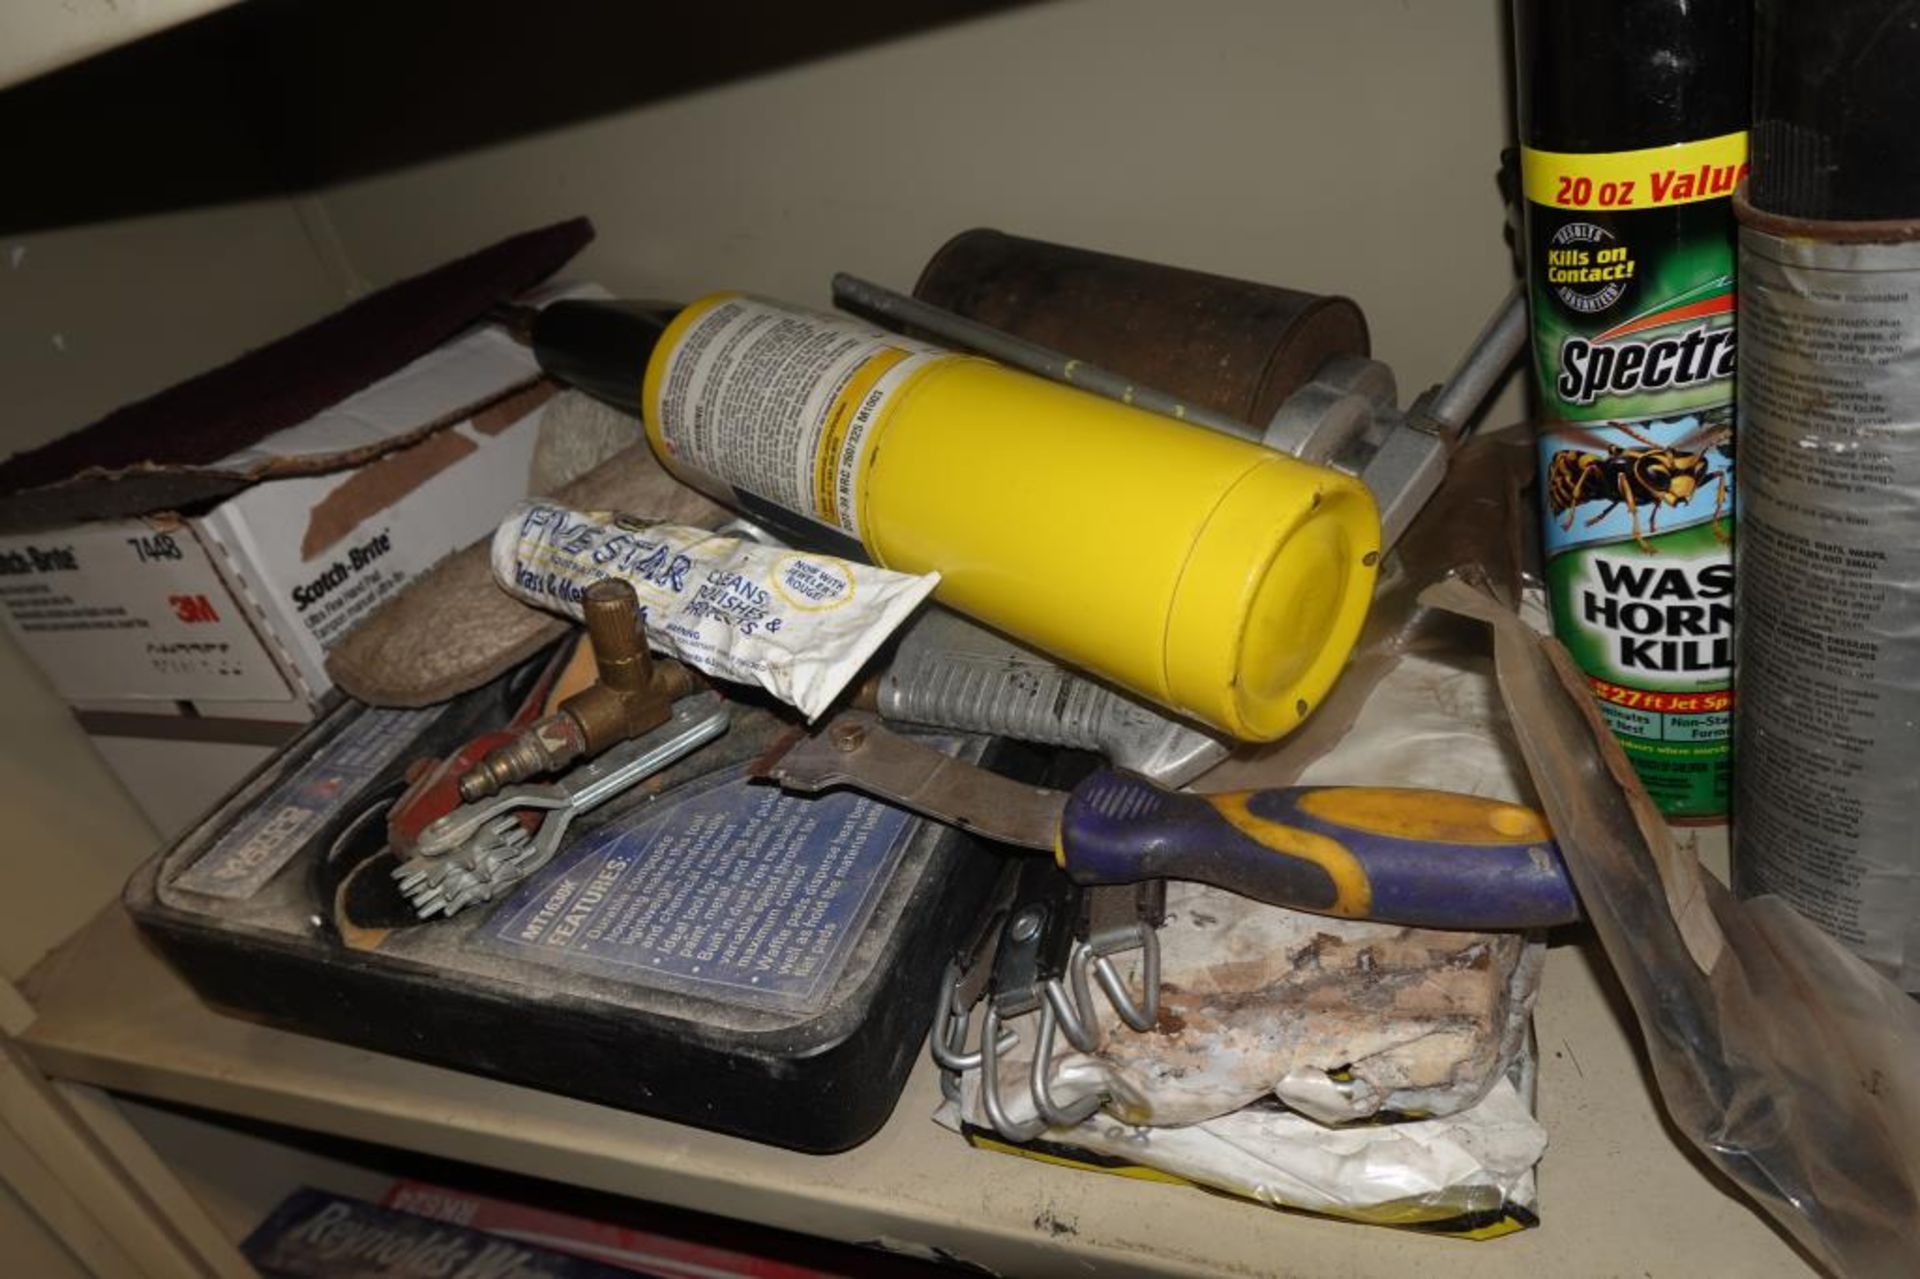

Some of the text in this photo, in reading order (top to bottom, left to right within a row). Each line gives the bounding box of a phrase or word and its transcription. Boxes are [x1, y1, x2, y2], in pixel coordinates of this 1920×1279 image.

[1556, 176, 1592, 206] 20
[1597, 181, 1636, 206] oz
[1548, 247, 1627, 266] Kills on
[1548, 260, 1635, 283] Contact!
[127, 534, 184, 563] 7448
[520, 505, 606, 555] FIVE
[593, 535, 691, 592] STAR
[292, 531, 391, 612] Scotch-Brite
[785, 567, 840, 598] JEWELER'S
[795, 560, 846, 590] NOW WITH
[168, 594, 220, 623] 3M
[765, 618, 784, 634] &
[1611, 686, 1641, 707] 27
[1645, 693, 1664, 709] ft
[1668, 698, 1698, 710] Jet
[641, 856, 674, 895] makes
[728, 858, 750, 882] and
[547, 856, 632, 946] FEATURES:
[641, 923, 663, 948] and
[658, 868, 701, 924] chemical
[730, 889, 752, 916] dust
[737, 863, 807, 969] maximum control
[786, 896, 811, 928] pads
[660, 920, 688, 954] Ideal
[683, 895, 705, 921] tool
[776, 944, 802, 977] well
[797, 927, 812, 944] as
[805, 897, 829, 928] hold
[822, 877, 841, 898] the
[810, 919, 836, 953] pads
